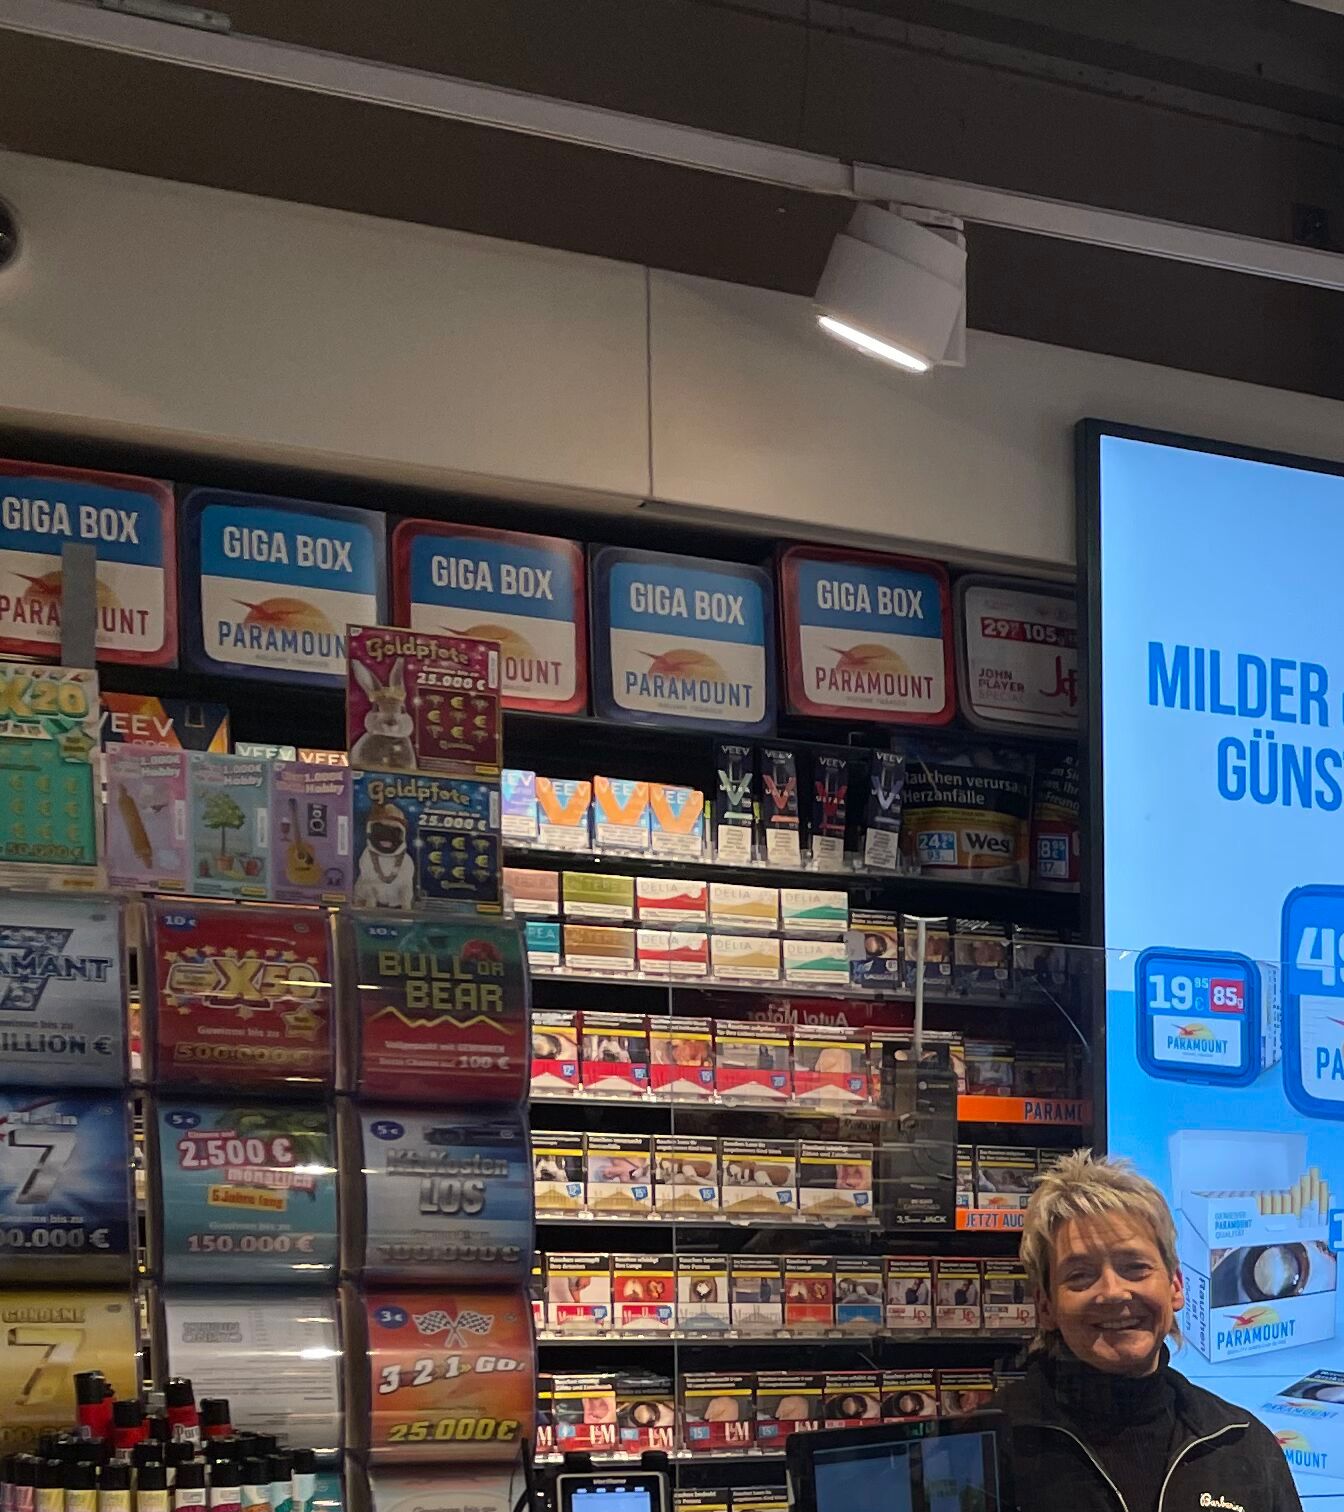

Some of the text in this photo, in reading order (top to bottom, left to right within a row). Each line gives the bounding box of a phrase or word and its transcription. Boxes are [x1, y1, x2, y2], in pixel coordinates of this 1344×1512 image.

[2, 496, 139, 545] GIGA BOX
[223, 525, 352, 572] GIGA BOX
[431, 555, 554, 601] GIGA BOX
[630, 581, 745, 626] GIGA BOX
[817, 579, 924, 620] GIGA BOX
[218, 620, 347, 659] PARAMOUN
[625, 671, 753, 710] PARAMOUNT
[815, 666, 934, 700] PARAMOUNT
[1148, 642, 1329, 727] MILDER
[379, 951, 473, 980] BULL
[405, 980, 503, 1012] BEAR
[1149, 975, 1192, 1010] 19
[1167, 1035, 1228, 1054] PARAMOUNT
[8, 1130, 76, 1204] 7
[179, 1138, 293, 1167] 2.500 €
[420, 1178, 486, 1213] LOS
[966, 1213, 998, 1228] JETZT
[1215, 1221, 1252, 1230] PARAMOUNT
[89, 1228, 110, 1248] €
[188, 1235, 290, 1252] 150.000
[1217, 1319, 1296, 1350] PARAMOUNT
[379, 1356, 461, 1394] 3 2 1
[589, 1424, 616, 1444] L&M
[648, 1427, 673, 1447] L&M
[725, 1421, 749, 1441] L&M
